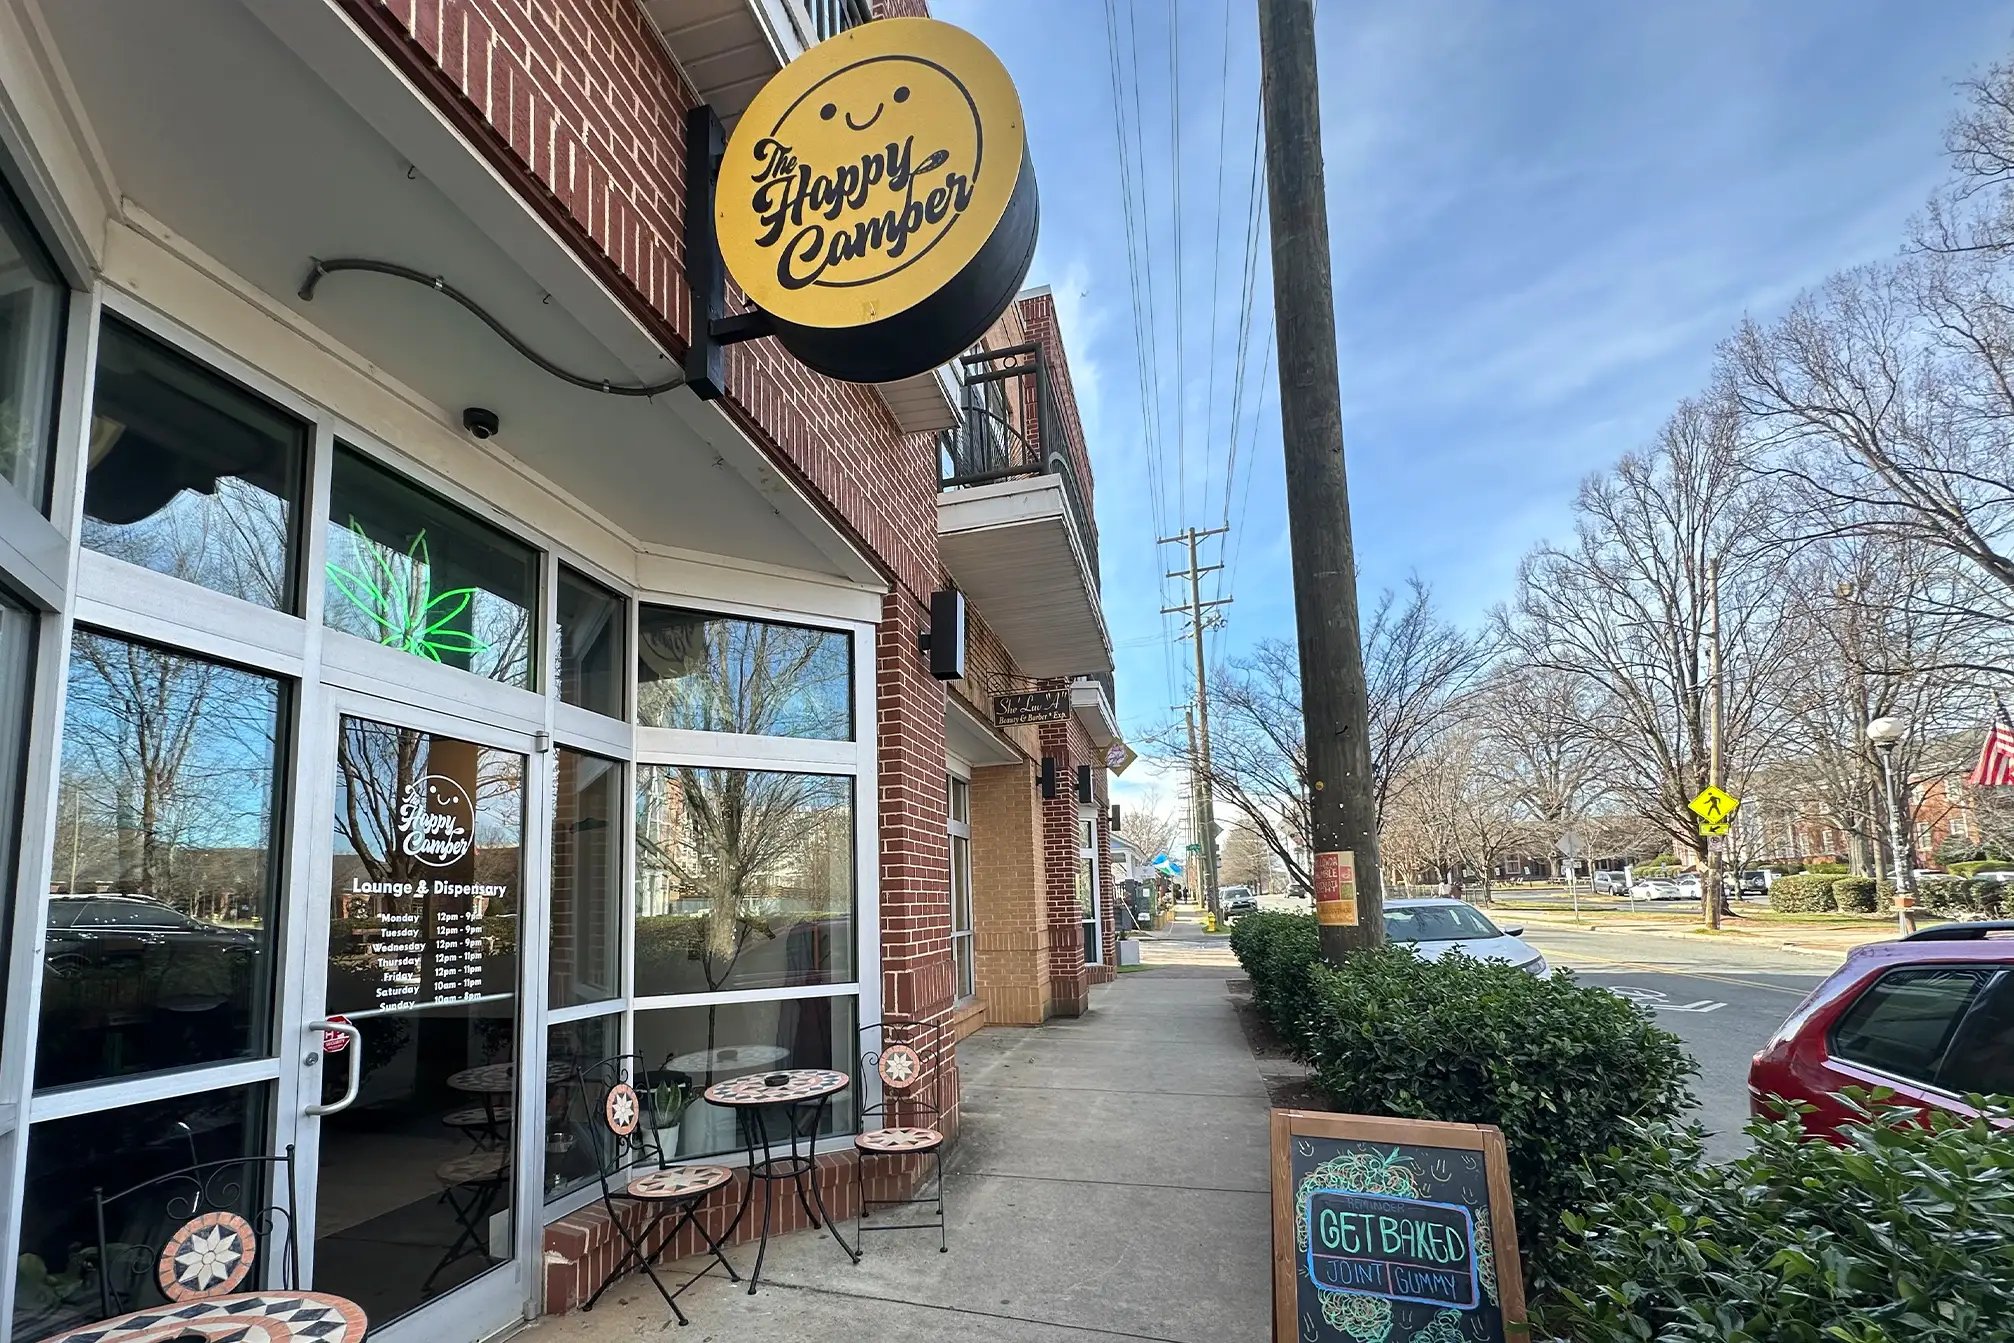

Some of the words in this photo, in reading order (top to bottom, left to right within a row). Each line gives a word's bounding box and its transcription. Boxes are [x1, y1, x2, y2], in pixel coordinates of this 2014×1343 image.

[751, 138, 798, 183] The
[752, 135, 914, 248] Happy
[777, 172, 975, 290] Camper
[398, 804, 456, 835] Happy
[403, 831, 469, 861] Camper
[353, 878, 412, 897] Lounge
[416, 879, 430, 894] &
[434, 880, 507, 898] Dispensary
[381, 913, 420, 924] Monday
[437, 912, 458, 922] 12pm
[465, 911, 483, 922] 9pm
[381, 928, 419, 938] Tuesday
[436, 926, 458, 936] 12pm
[465, 925, 482, 935] 9pm
[372, 942, 426, 952] Wednesday
[436, 940, 457, 950] 12pm
[464, 938, 482, 949] 9pm
[378, 957, 420, 967] Thursday
[435, 953, 457, 964] 12pm
[464, 952, 482, 962] 11pm
[383, 972, 414, 982] Friday
[435, 967, 456, 977] 12pm
[463, 965, 482, 975] 11pm
[376, 985, 420, 998] Saturday
[434, 981, 456, 991] 10am
[463, 978, 482, 988] 11pm
[379, 1000, 415, 1012] Sunday
[1319, 1209, 1375, 1254] GET
[1379, 1216, 1465, 1264] BAKED
[1326, 1260, 1382, 1286] JOINT
[1395, 1268, 1456, 1300] GUMMY
